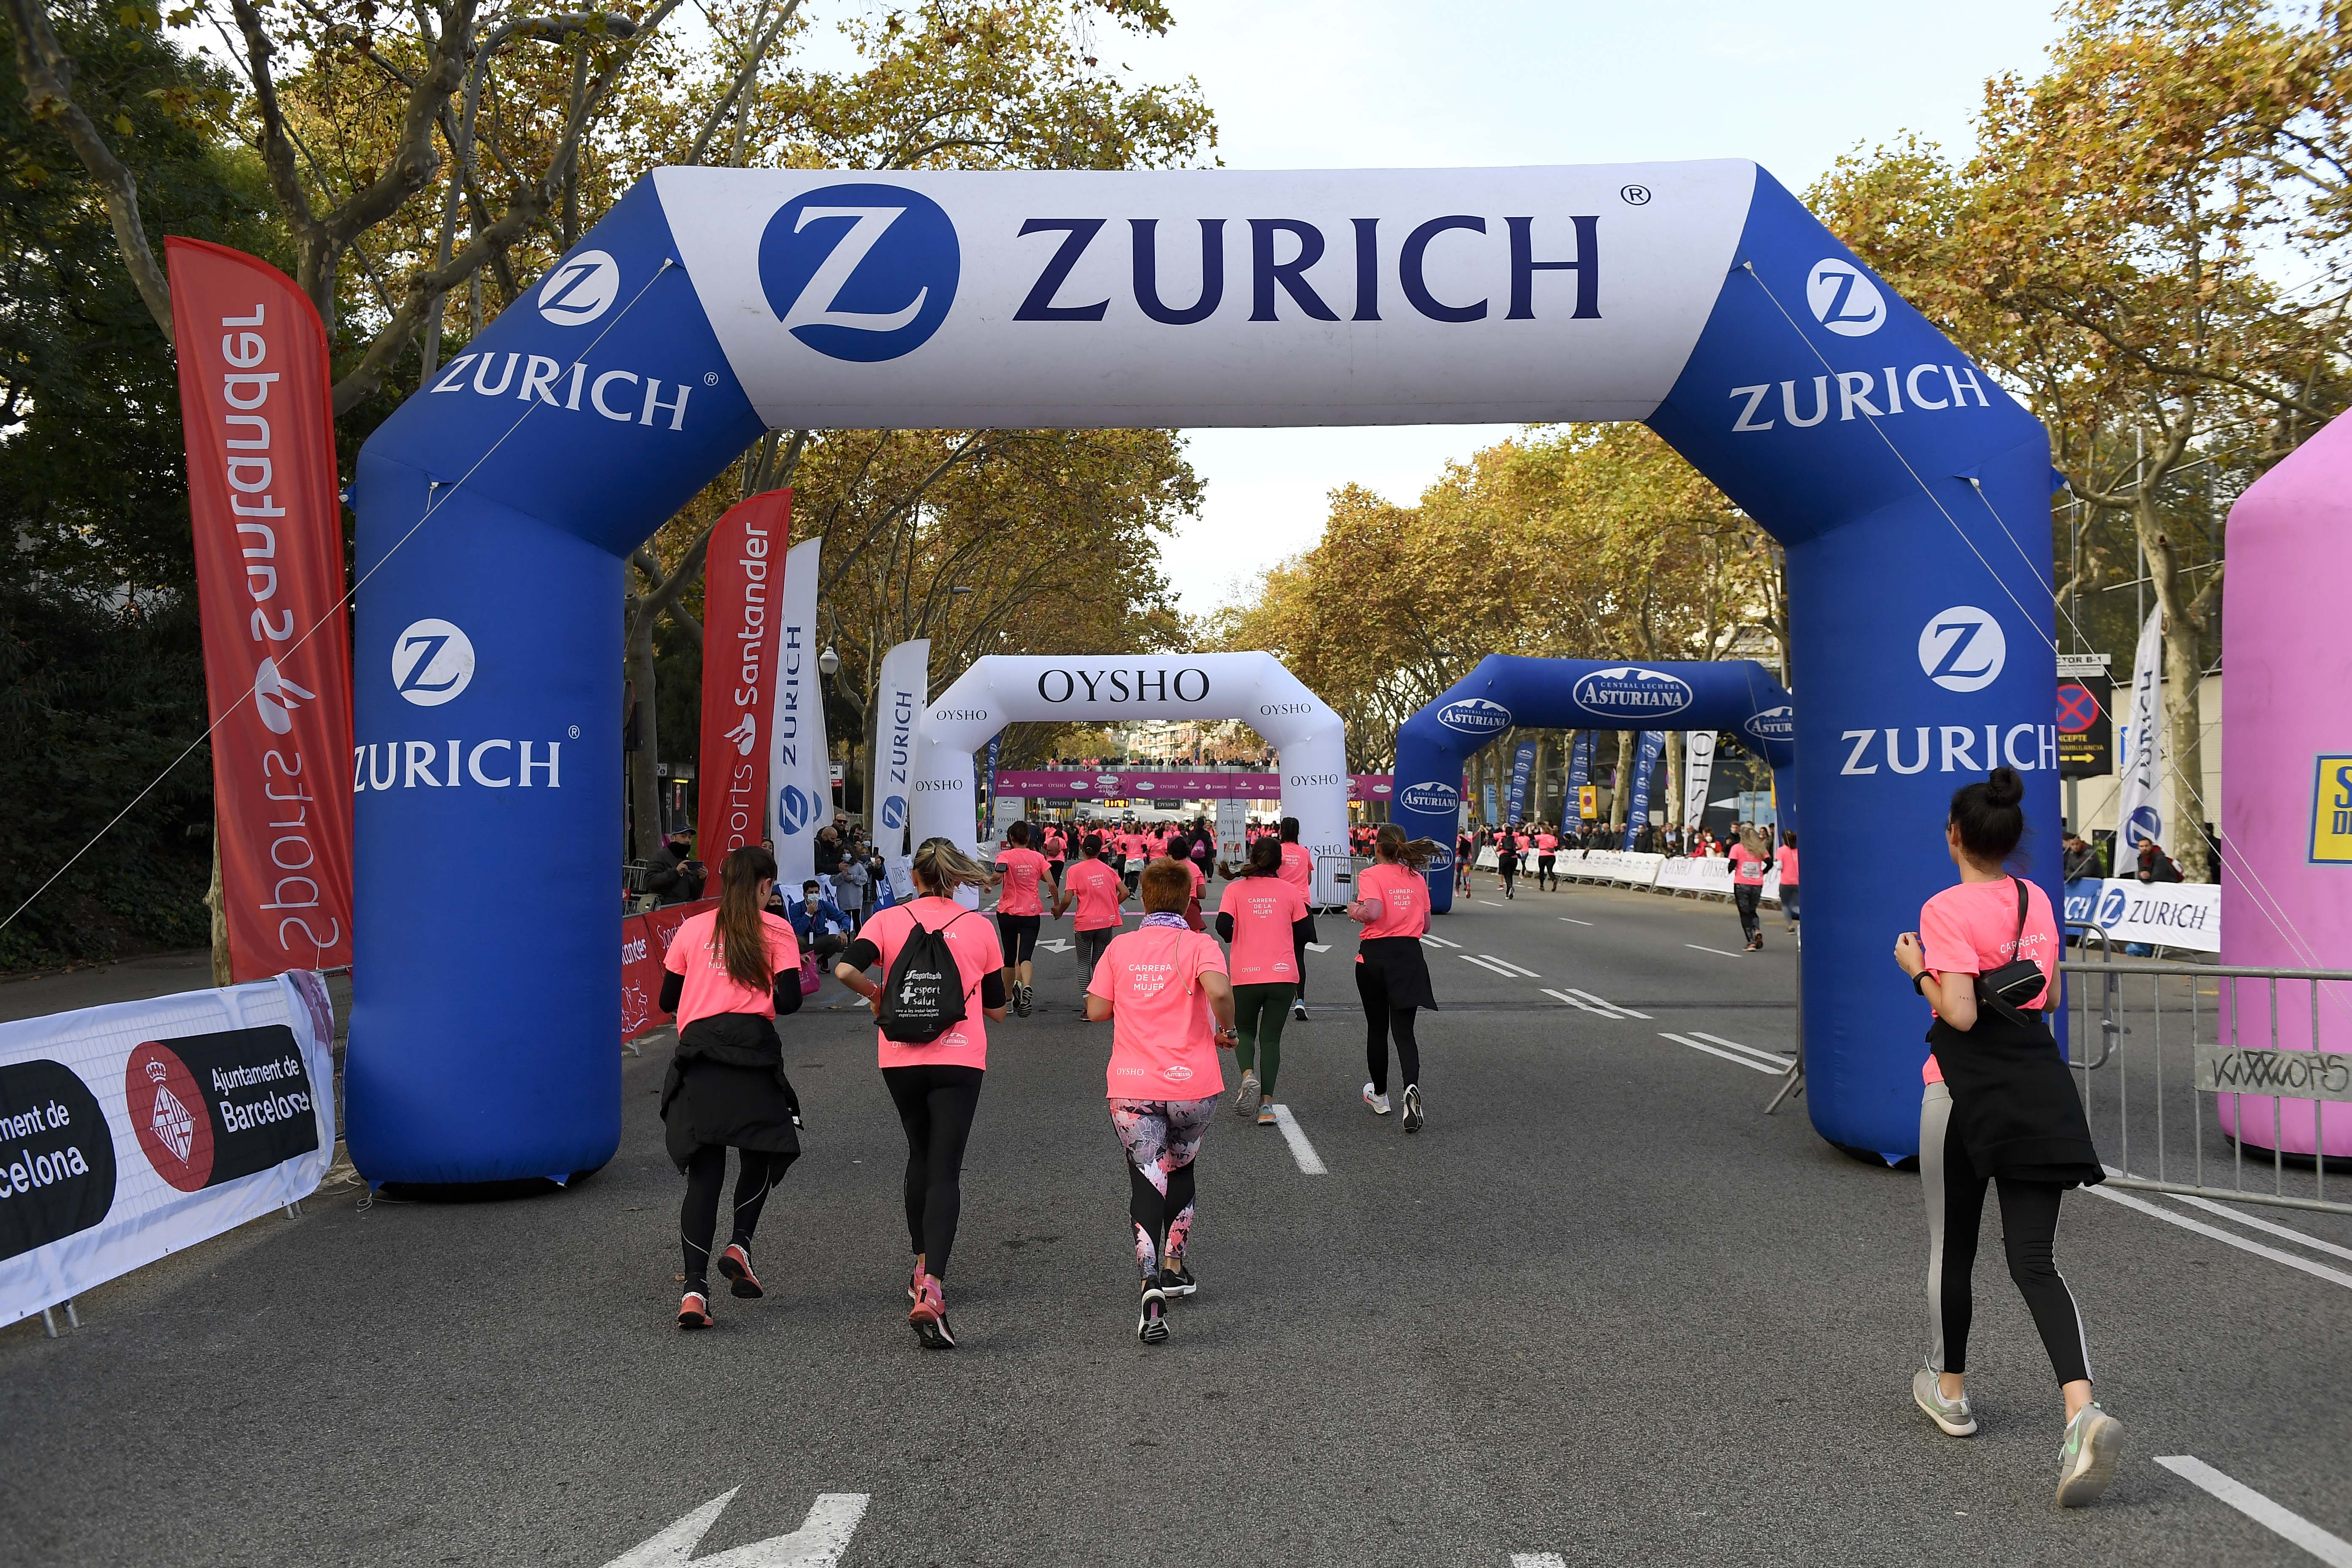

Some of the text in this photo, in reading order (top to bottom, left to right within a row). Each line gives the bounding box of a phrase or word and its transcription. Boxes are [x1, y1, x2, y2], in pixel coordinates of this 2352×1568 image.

[1012, 215, 1602, 325] ZURICH
[430, 352, 693, 431] ZURICH
[1729, 364, 1991, 432] ZURICH
[735, 522, 769, 707] Santander
[782, 626, 801, 767] ZURICH
[1037, 668, 1210, 702] OYSHO
[1583, 682, 1682, 707] ASTURIANA
[936, 709, 987, 721] OYSHO
[1260, 703, 1312, 716] OYSHO
[1443, 709, 1506, 726] ASTURIANA
[890, 691, 912, 784] ZURICH
[1840, 724, 2057, 775] ZURICH
[354, 739, 561, 792] ZURICH
[915, 779, 964, 792] OYSHO
[1290, 773, 1338, 787] OYSHO
[1405, 791, 1456, 807] ASTURIANA
[1304, 844, 1342, 856] YSHO
[2127, 900, 2208, 930] ZURICH
[2000, 933, 2047, 953] CARRERA
[2025, 948, 2038, 960] LA
[1128, 964, 1172, 972] CARRERA
[912, 996, 936, 1006] salut
[914, 985, 941, 996] esport
[211, 1055, 300, 1097] Ajuntament de
[1116, 1068, 1144, 1076] OYSHO
[46, 1098, 71, 1127] de
[219, 1089, 310, 1134] Barcelona
